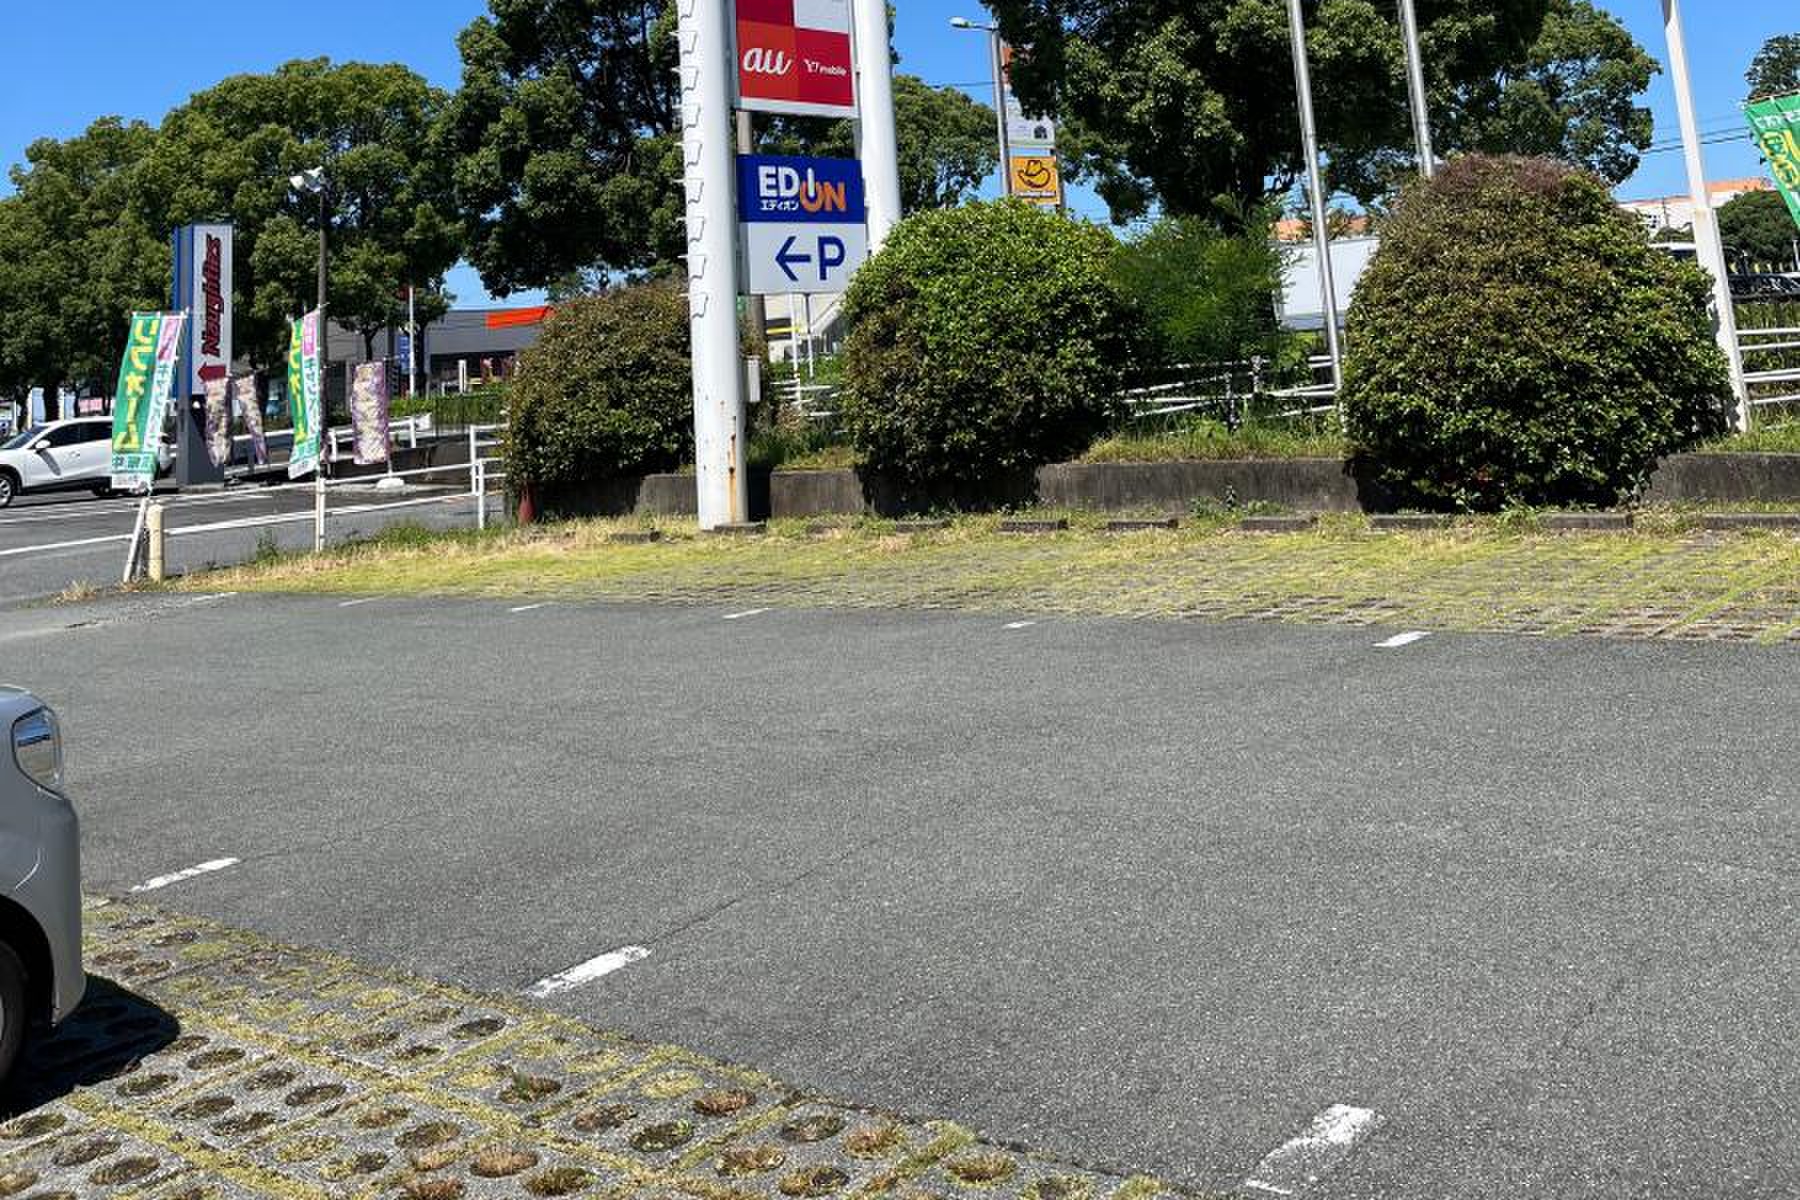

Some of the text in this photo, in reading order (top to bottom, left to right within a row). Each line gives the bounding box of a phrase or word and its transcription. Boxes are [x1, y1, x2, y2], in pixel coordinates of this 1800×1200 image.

[742, 47, 793, 76] au
[758, 165, 847, 212] EDION
[817, 235, 846, 280] P
